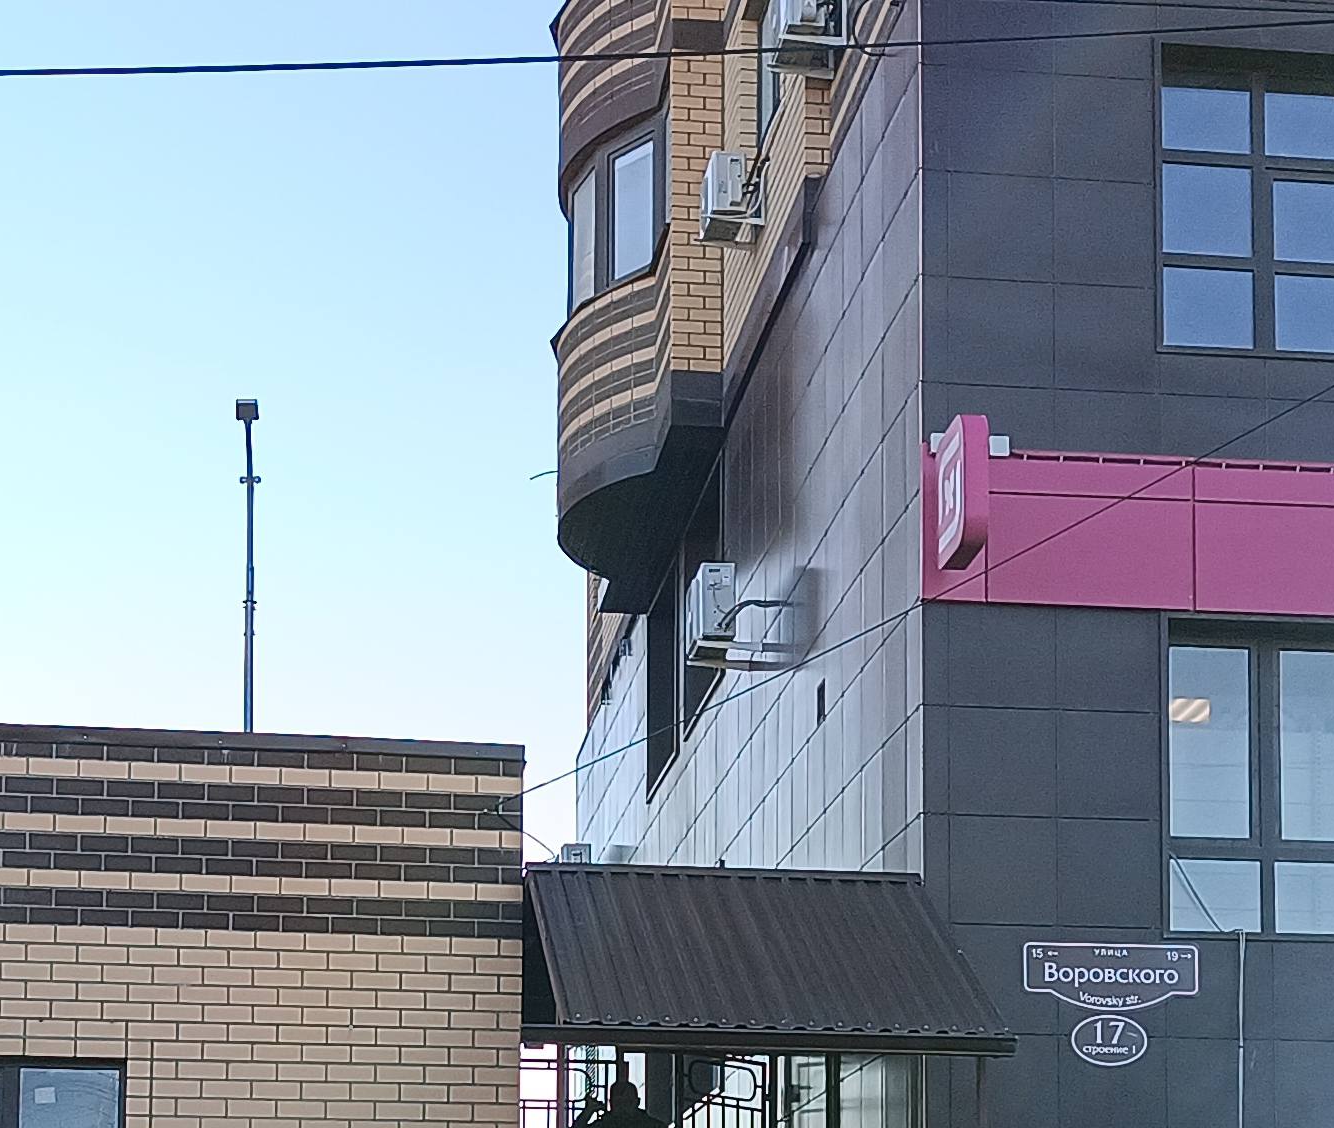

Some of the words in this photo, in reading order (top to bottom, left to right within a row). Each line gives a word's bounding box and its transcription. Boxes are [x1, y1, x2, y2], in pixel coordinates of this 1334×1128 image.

[1031, 948, 1044, 959] 15
[1166, 951, 1178, 961] 19
[1044, 962, 1179, 987] Воровского
[1079, 991, 1125, 1007] Vorovsky
[1125, 995, 1142, 1004] str.
[1093, 1020, 1125, 1045] 17
[1082, 1045, 1129, 1055] строение
